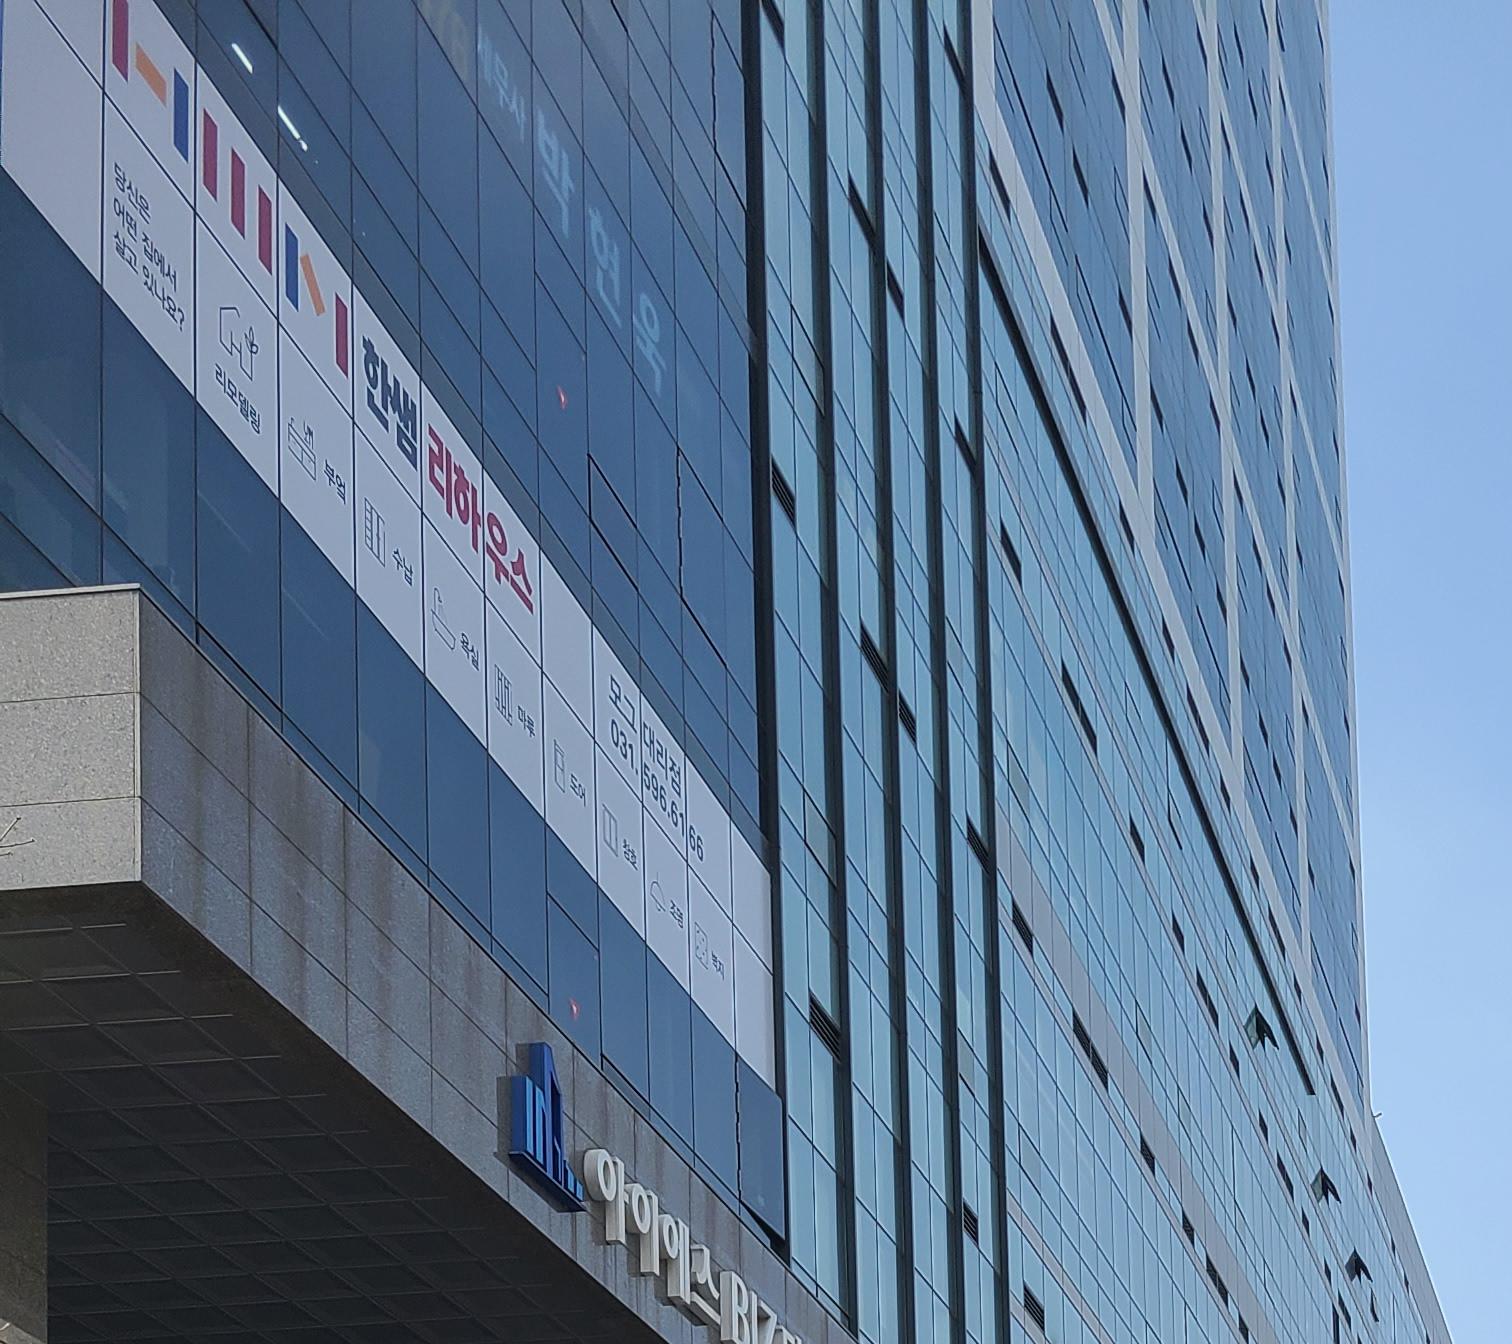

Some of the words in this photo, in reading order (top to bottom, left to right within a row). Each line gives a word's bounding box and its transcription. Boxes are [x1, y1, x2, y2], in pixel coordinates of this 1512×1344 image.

[114, 161, 151, 225] 당신은
[113, 197, 138, 244] 어떤
[142, 231, 177, 293] 집에서
[113, 230, 139, 275] 살고
[142, 265, 185, 332] 있나요?
[214, 362, 261, 435] 리모델링
[323, 459, 346, 505] 부엌
[362, 334, 419, 473] 한샘
[427, 423, 535, 616] 리하우스
[391, 548, 414, 587] 수납
[460, 631, 480, 672] 욕실
[517, 705, 536, 738] 마루
[608, 673, 638, 735] 모그
[642, 720, 682, 799] 대리점
[569, 773, 587, 808] 도어
[622, 838, 639, 871] 창호
[669, 899, 684, 929] 조명
